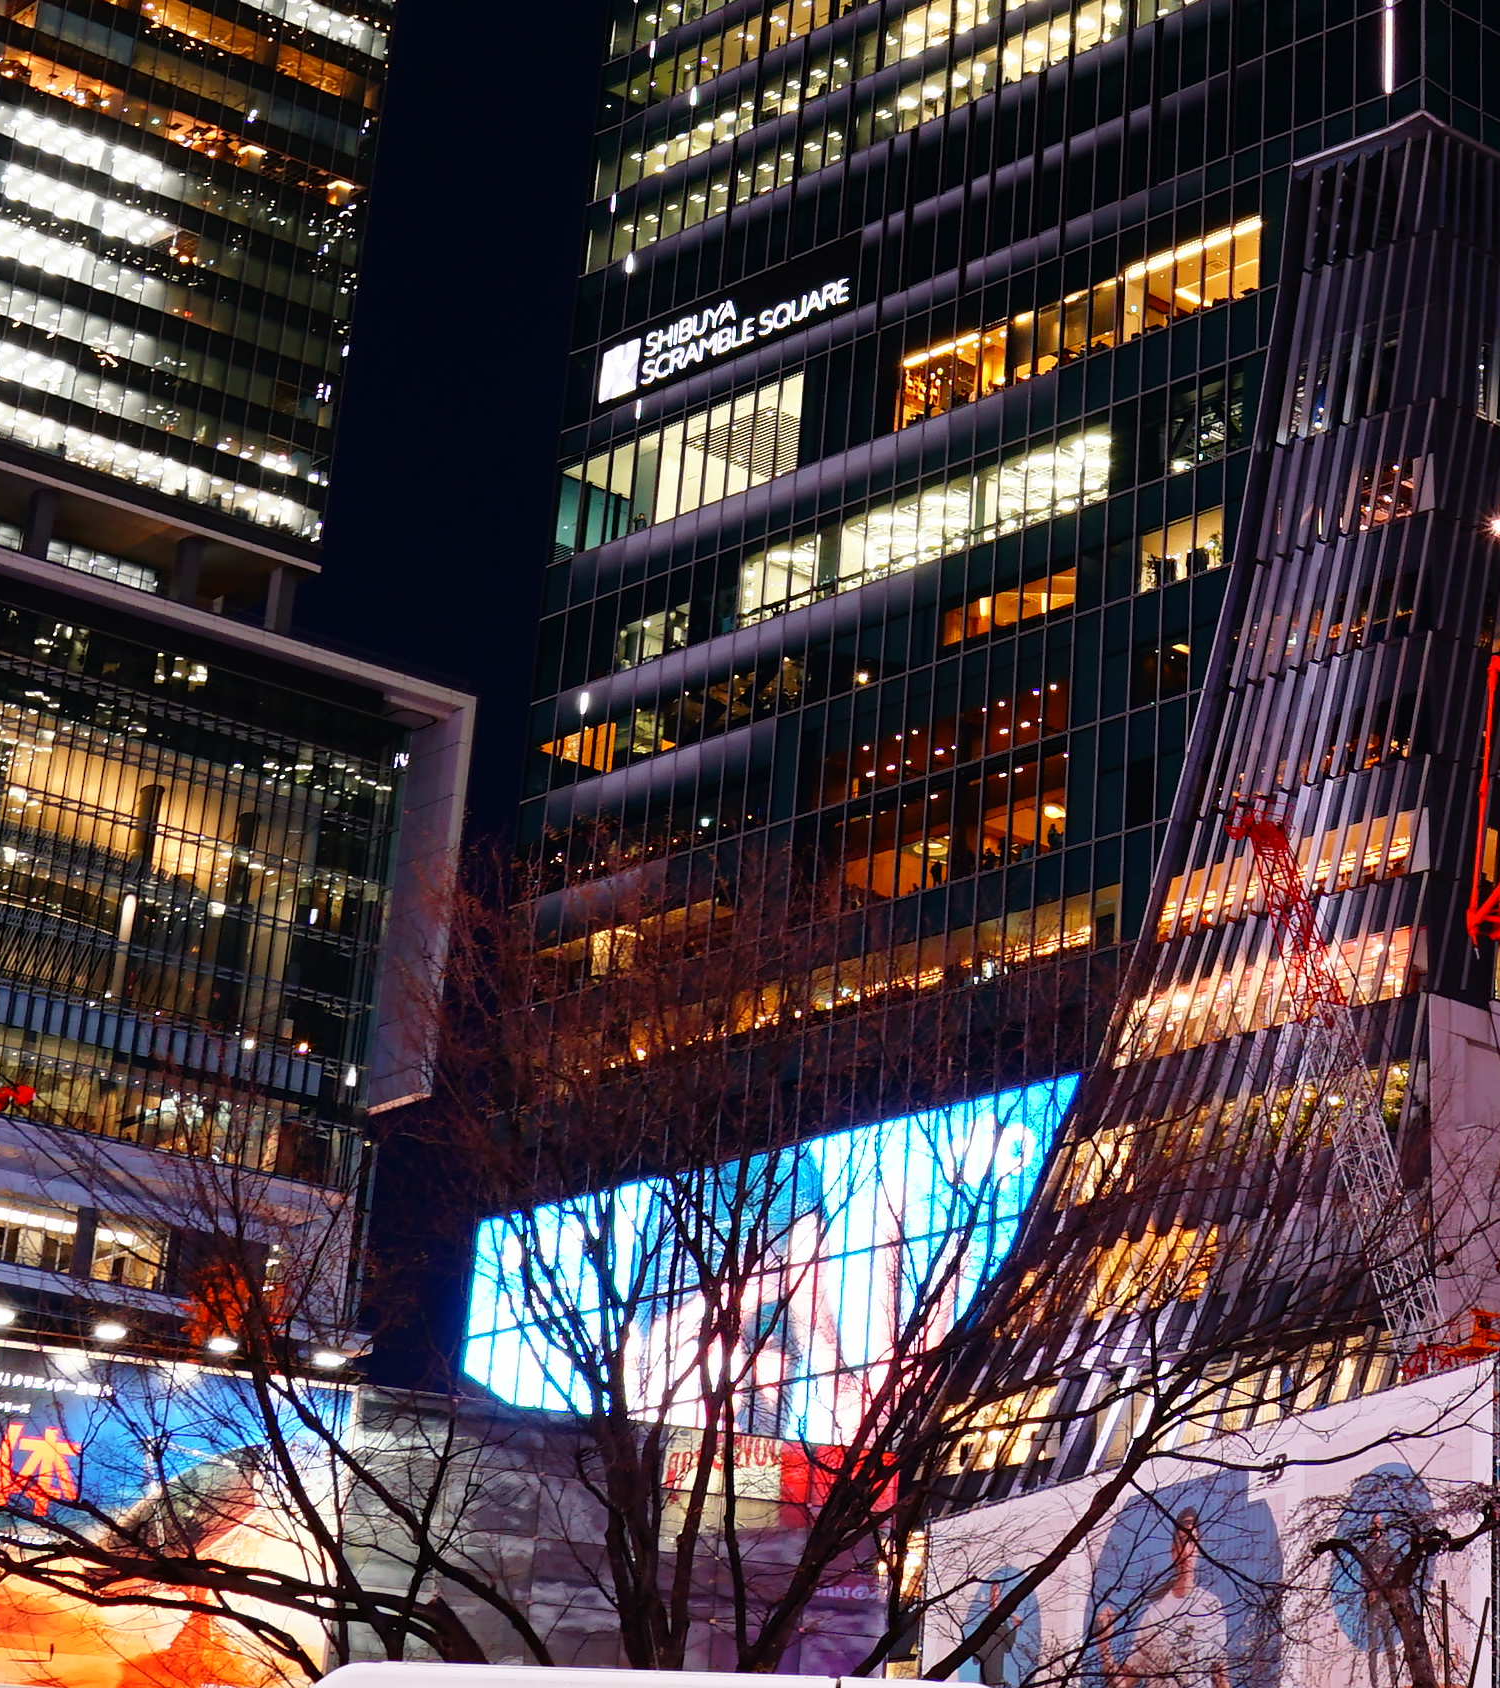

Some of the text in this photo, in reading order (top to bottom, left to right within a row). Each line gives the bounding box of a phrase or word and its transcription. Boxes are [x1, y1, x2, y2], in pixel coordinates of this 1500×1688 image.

[640, 277, 850, 385] SCRAMBLE SQUARE
[643, 299, 737, 358] SHIBUYA
